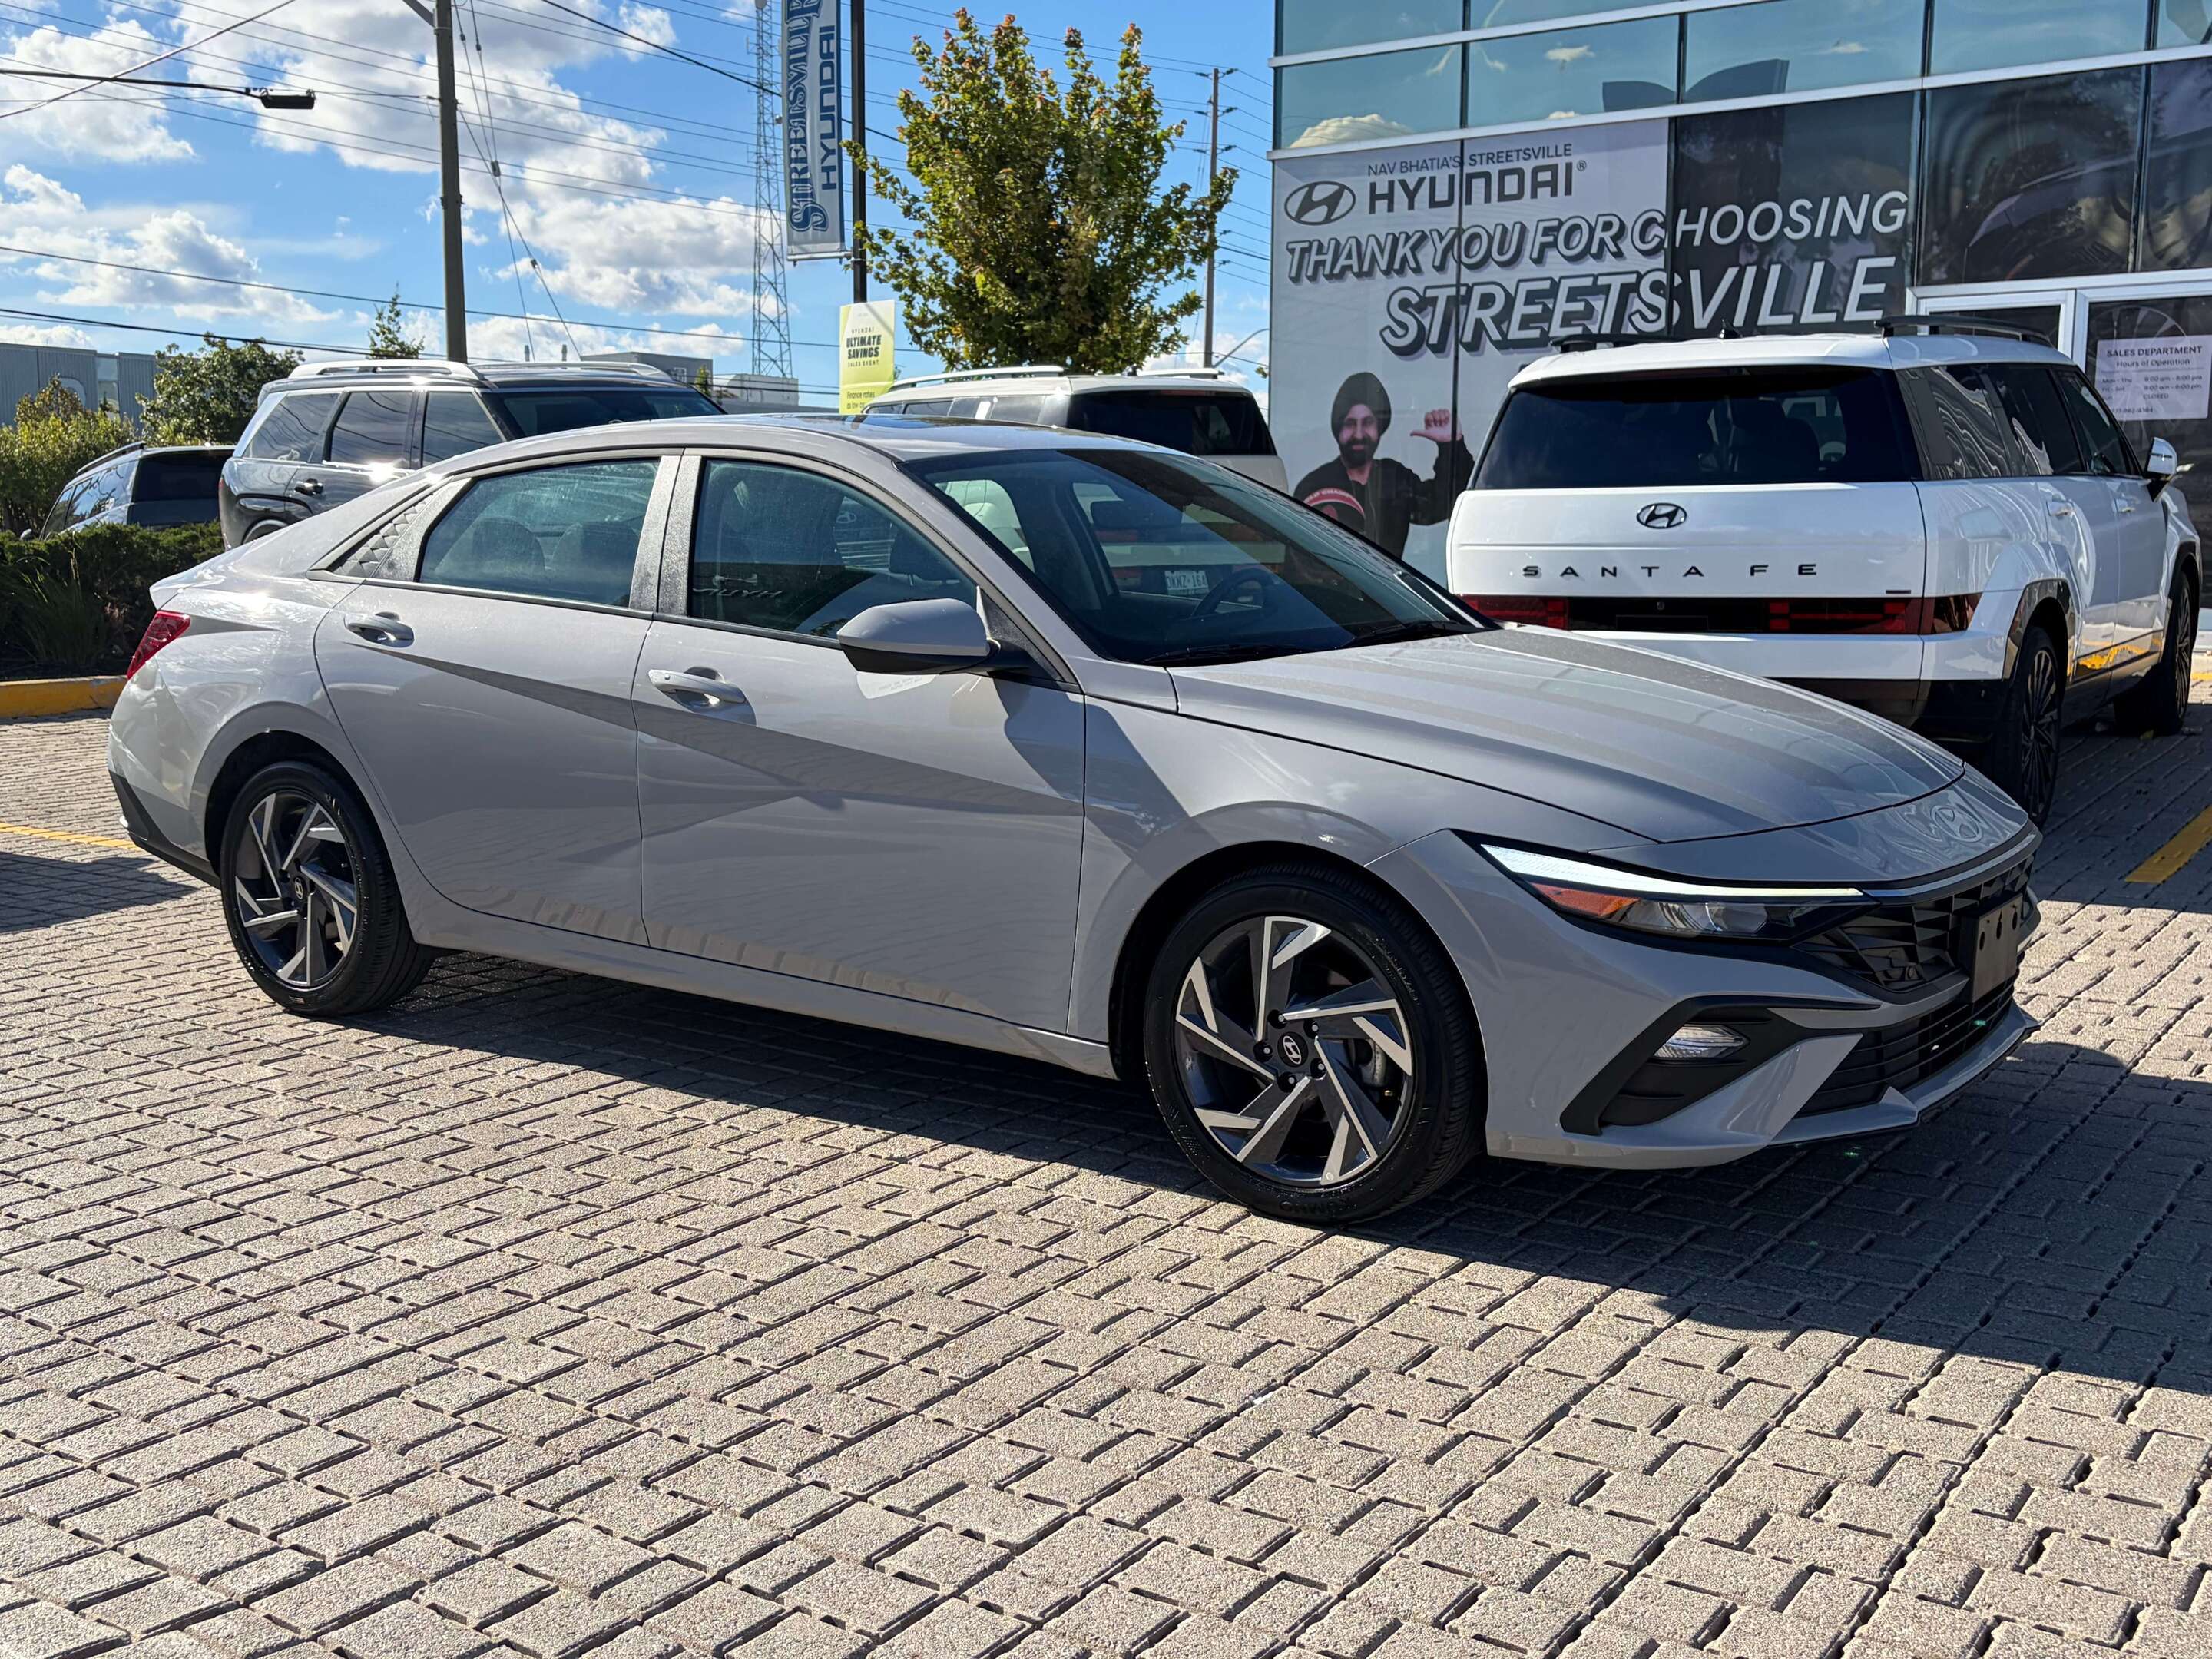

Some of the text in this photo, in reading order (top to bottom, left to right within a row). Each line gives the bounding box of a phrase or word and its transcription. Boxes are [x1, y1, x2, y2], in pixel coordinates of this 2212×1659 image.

[785, 0, 829, 232] STREETSVILLE
[819, 25, 837, 190] HYUNDAI
[1368, 144, 1573, 177] NAV BHATIA'S STREETSVILLE
[1286, 190, 1909, 284] THANK YOU FOR CHOOSING
[1379, 256, 1896, 356] STREETSVILLE
[846, 334, 882, 348] ULTIMATE
[847, 346, 879, 359] SAVINGS
[2107, 346, 2202, 358] SALES DEPARTMENT
[2150, 358, 2190, 367] Operation
[1522, 564, 1817, 578] SANTA FE
